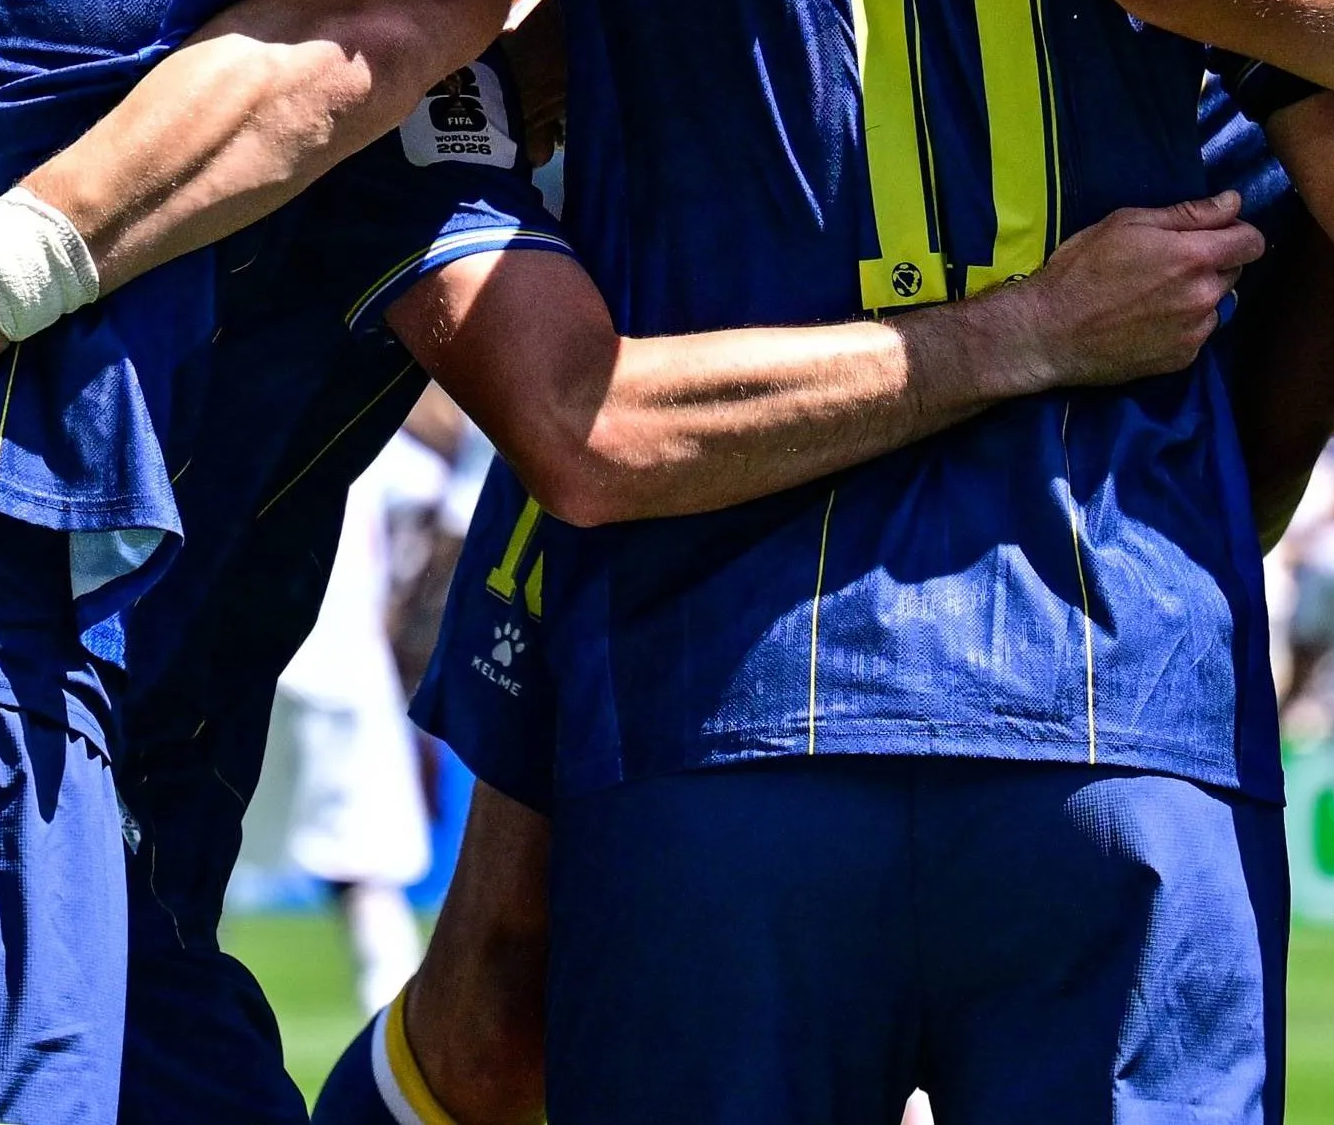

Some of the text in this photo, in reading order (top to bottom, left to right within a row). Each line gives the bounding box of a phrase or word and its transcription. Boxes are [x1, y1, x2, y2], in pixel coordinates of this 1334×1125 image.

[447, 116, 474, 126] FIFA
[435, 134, 490, 143] WORLD CUP
[436, 142, 492, 155] 2026
[470, 655, 522, 697] KELME
